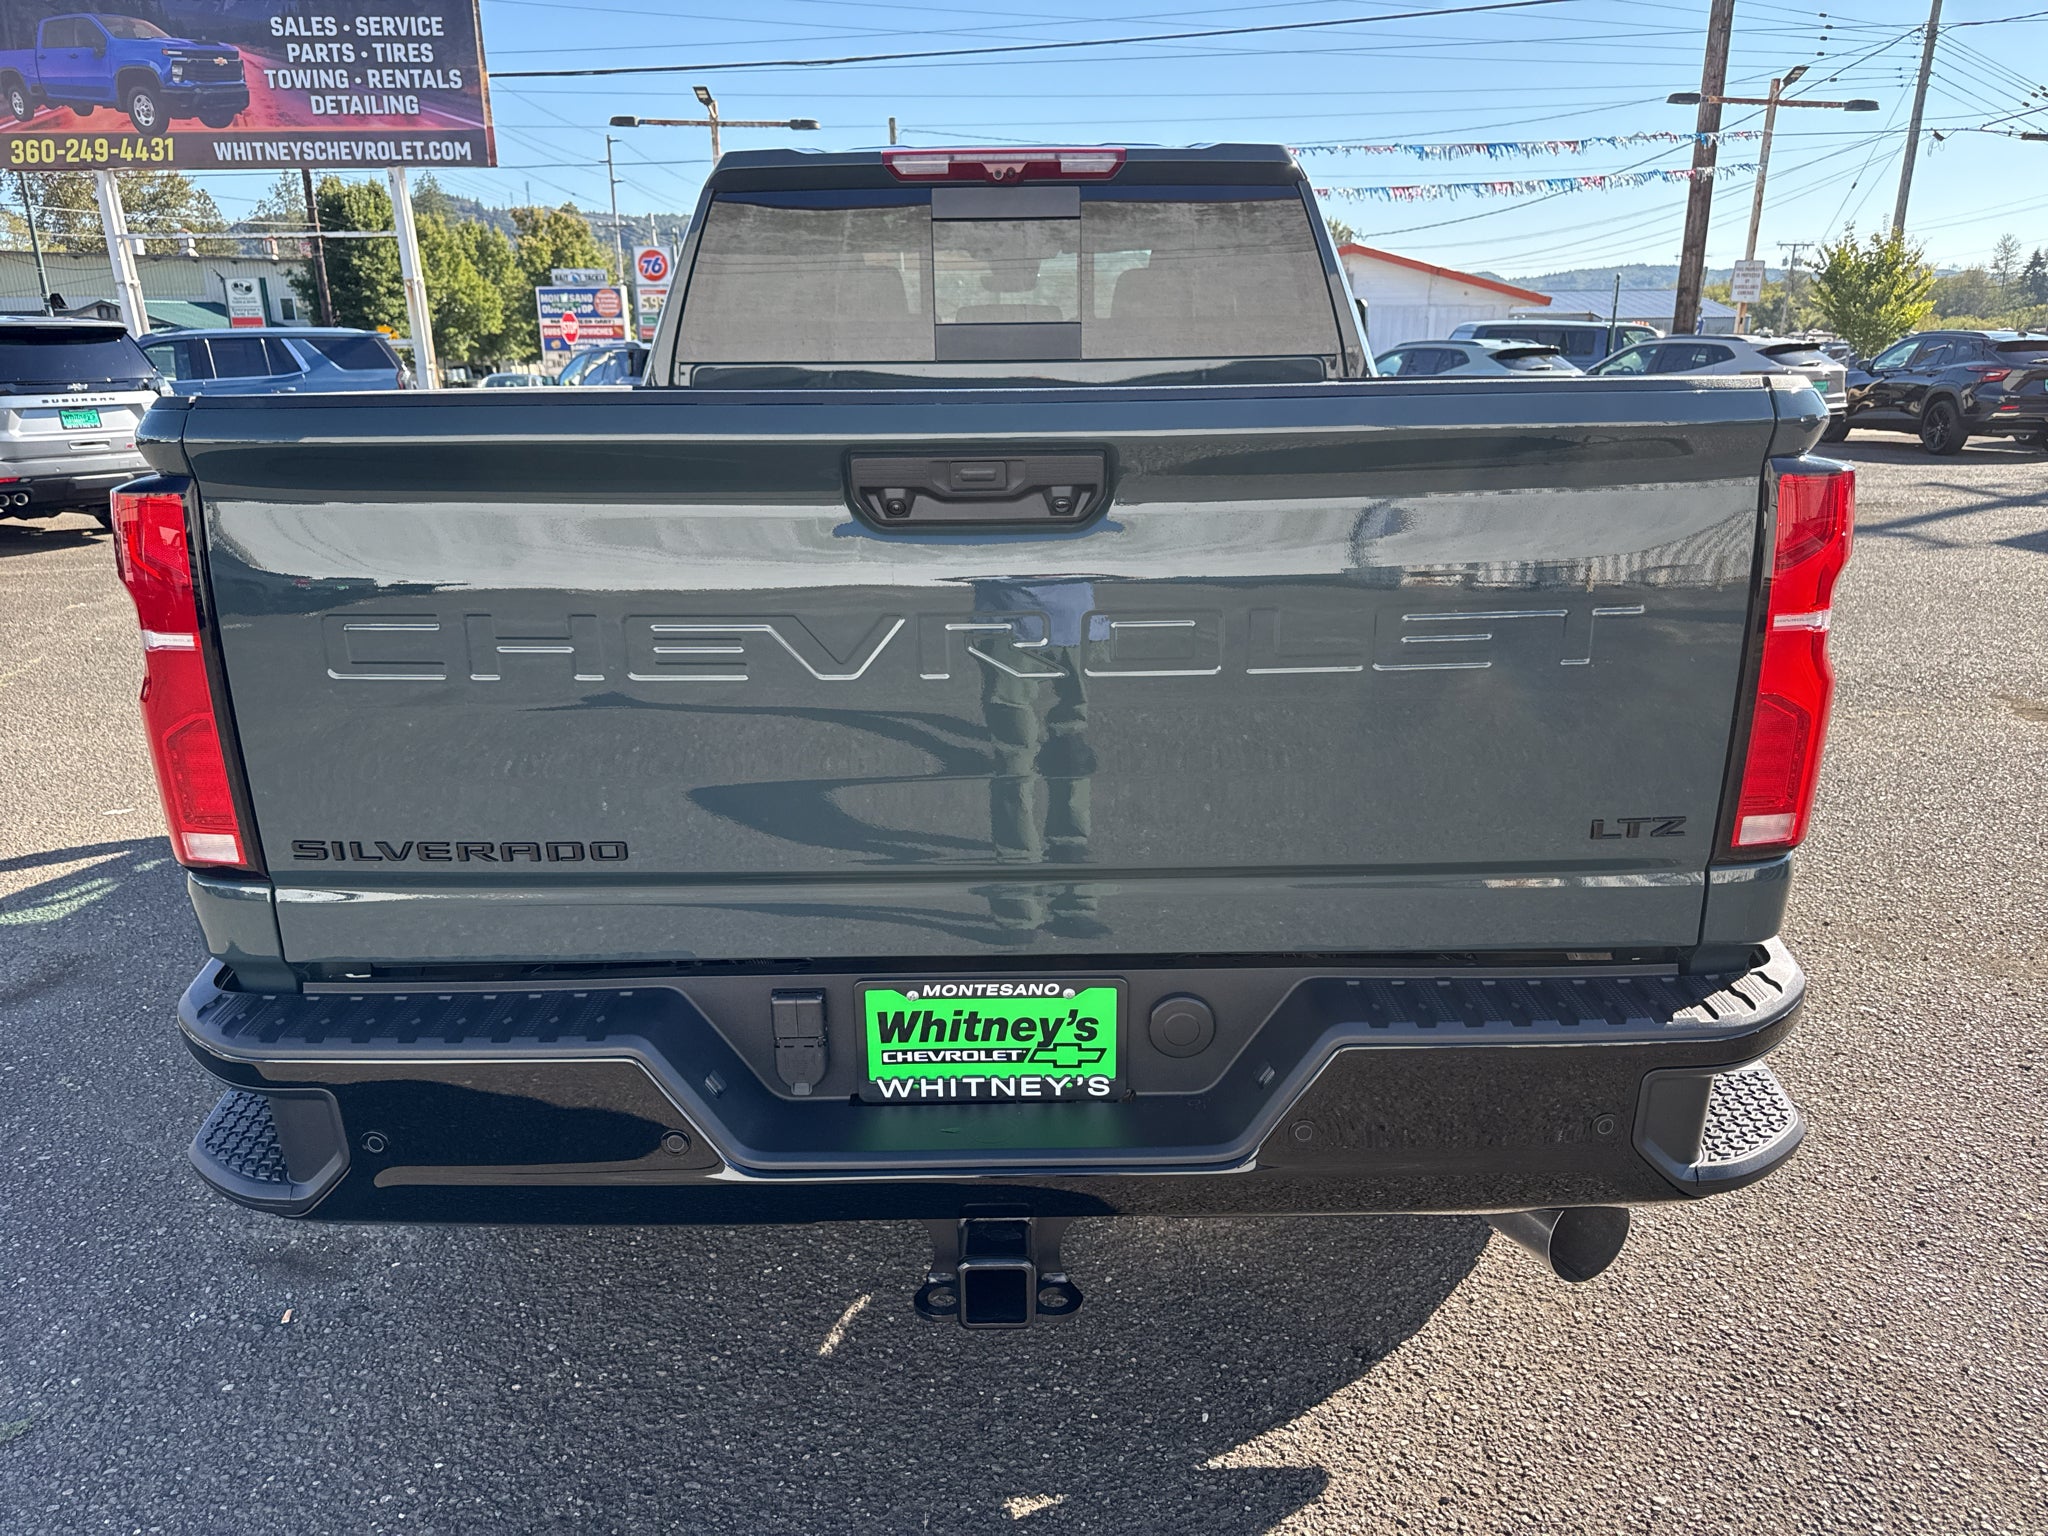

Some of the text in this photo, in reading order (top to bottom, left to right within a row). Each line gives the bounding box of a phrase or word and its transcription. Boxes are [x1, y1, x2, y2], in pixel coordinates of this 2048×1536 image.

[270, 16, 445, 37] SALES SERVICE
[286, 43, 434, 63] PARTS TIRES
[263, 69, 463, 89] TOWING RENTALS
[310, 95, 420, 115] DETAILING
[10, 137, 175, 164] 360-249-4431
[213, 140, 473, 162] WHITNEYSCHEVROLET.COM
[642, 257, 663, 274] 76
[540, 293, 593, 303] MONSANO
[561, 321, 577, 334] STOP
[324, 604, 1645, 682] CHEVROLET
[1589, 816, 1687, 840] LTZ
[291, 839, 629, 862] SILVERADO
[922, 983, 1060, 997] MONTESANO
[877, 1009, 1099, 1048] Whitney's
[882, 1050, 1023, 1063] CHEVROLET
[877, 1076, 1110, 1098] WHITNEY'S
